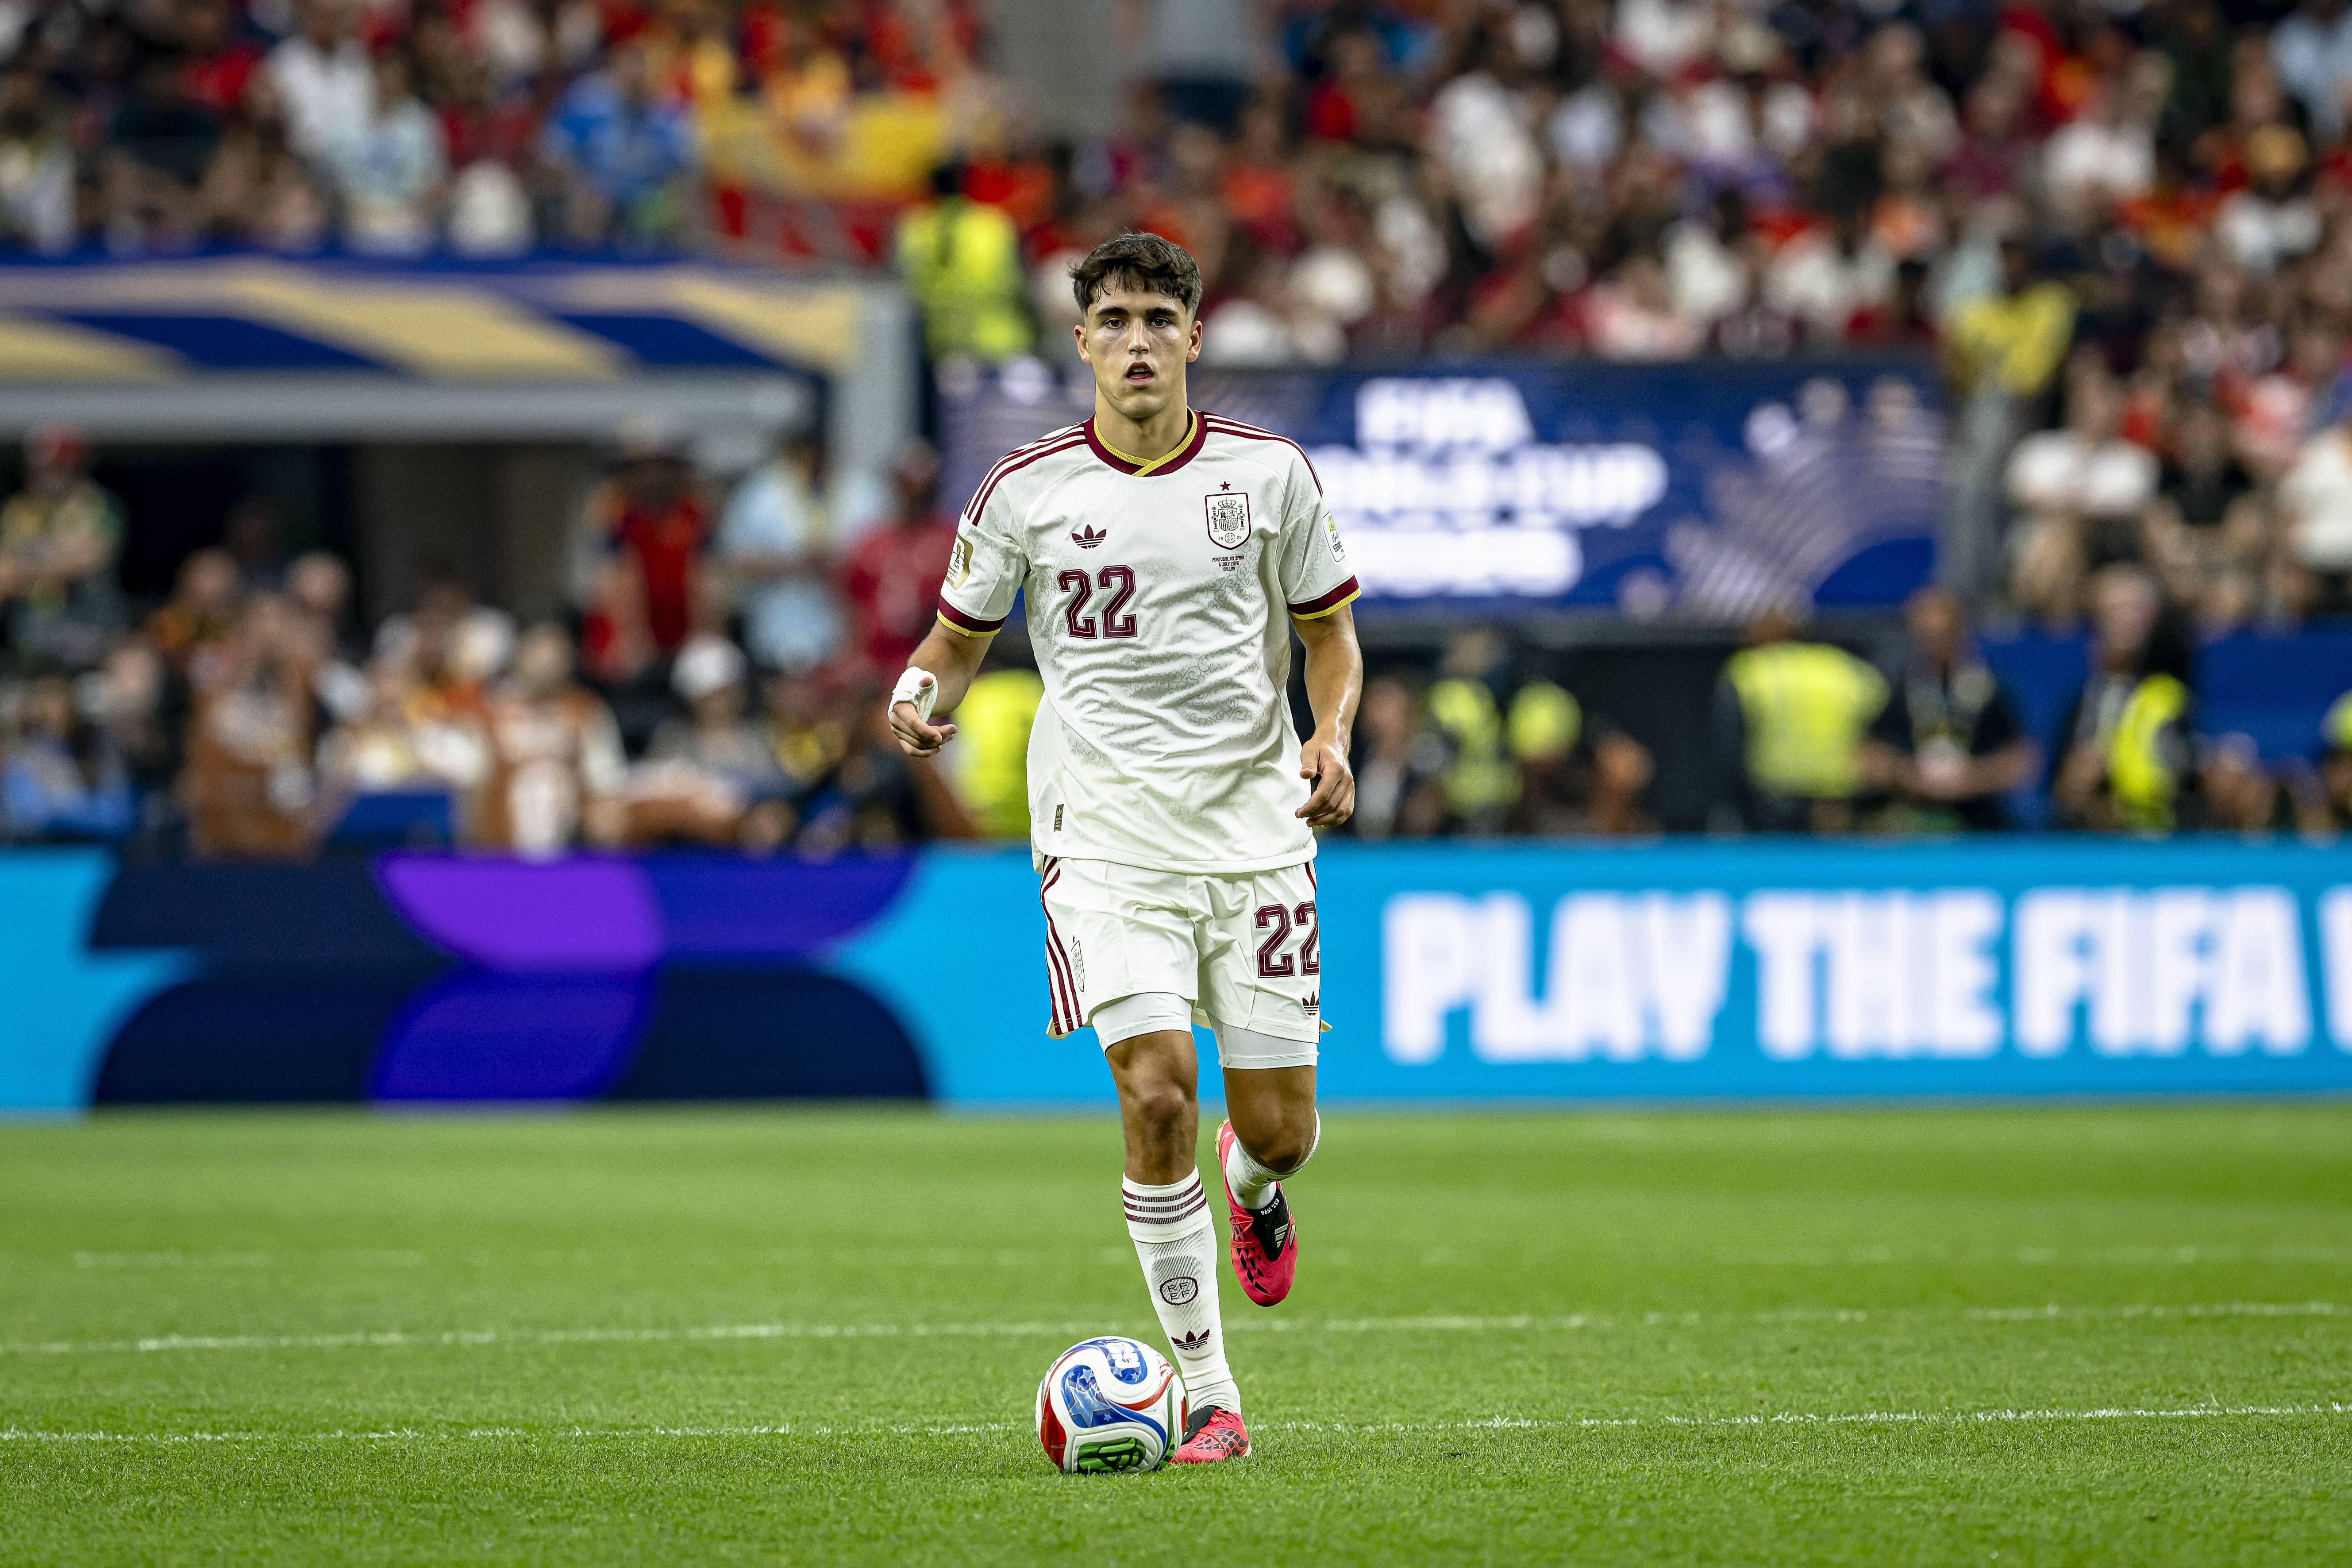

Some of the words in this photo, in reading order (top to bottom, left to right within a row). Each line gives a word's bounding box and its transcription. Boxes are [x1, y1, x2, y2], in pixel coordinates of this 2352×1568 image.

[1057, 565, 1138, 639] 22
[1254, 901, 1320, 978] 22
[1386, 894, 1731, 1061] PLAY
[1743, 893, 2001, 1056] THE
[2017, 891, 2308, 1053] FIFA
[1261, 1207, 1272, 1216] 1994
[1271, 1198, 1280, 1209] EST.
